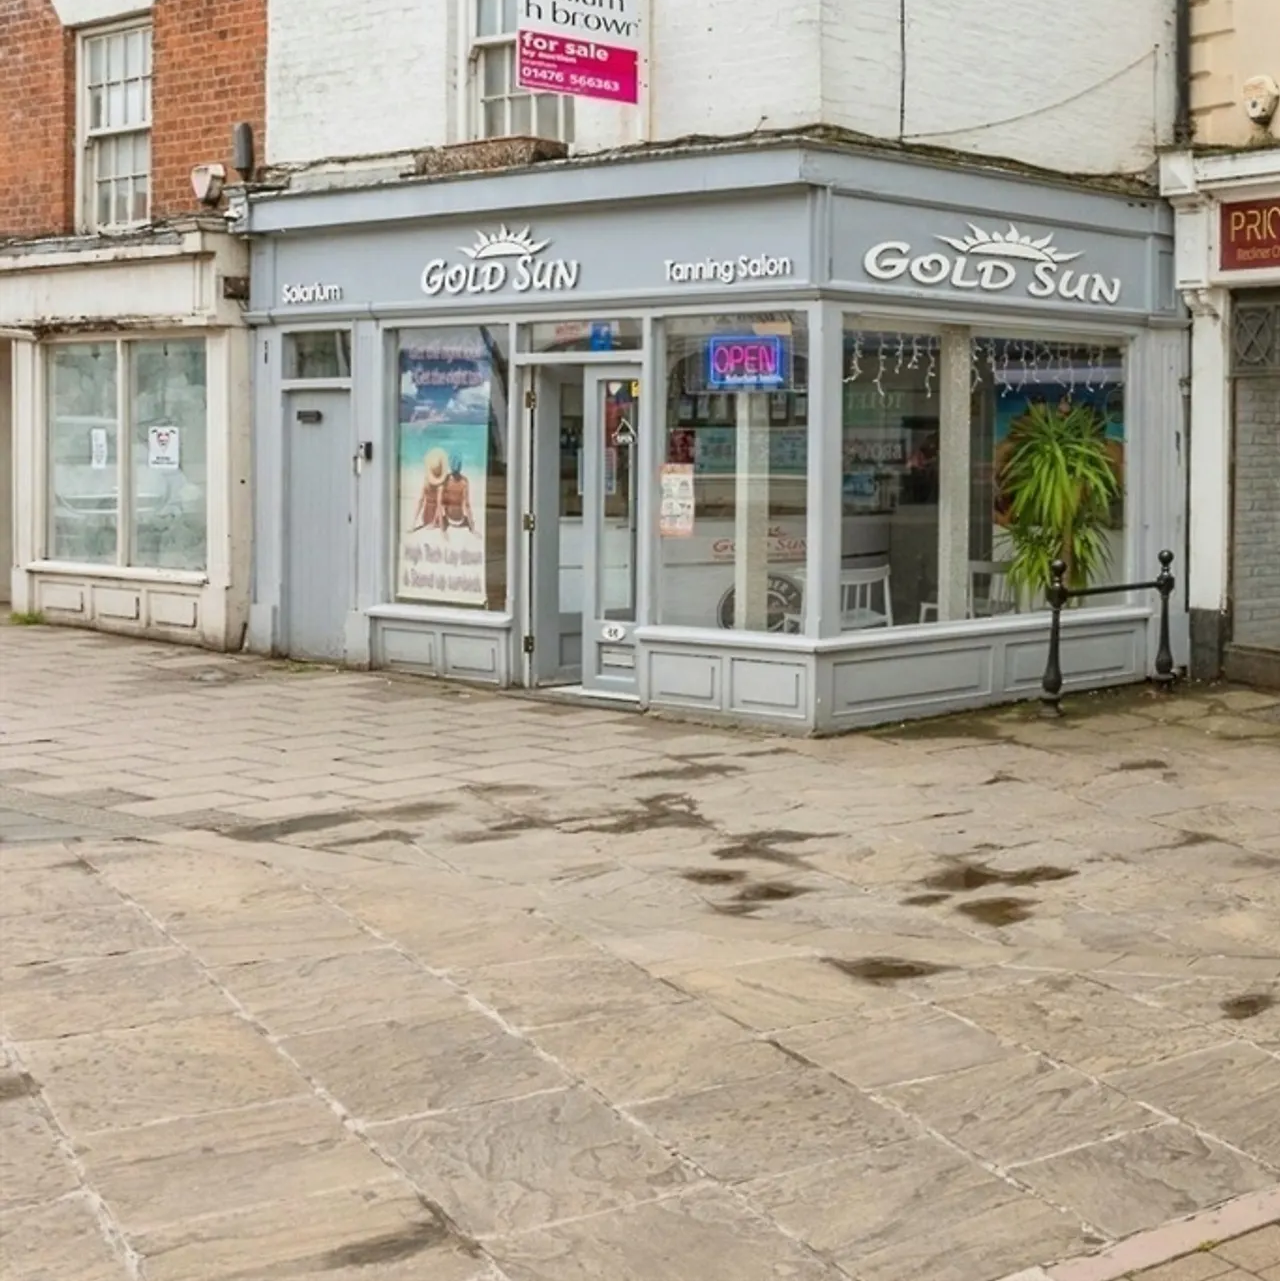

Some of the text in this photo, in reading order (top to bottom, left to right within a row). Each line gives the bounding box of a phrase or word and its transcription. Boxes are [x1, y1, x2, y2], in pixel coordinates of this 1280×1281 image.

[522, 32, 610, 61] for sale
[521, 66, 565, 83] 01476
[420, 253, 581, 296] GOLD SUN
[664, 253, 792, 284] Tanning Salon
[863, 240, 1122, 305] GOLD SUN
[282, 283, 342, 304] Solarium
[713, 345, 777, 374] OPEN
